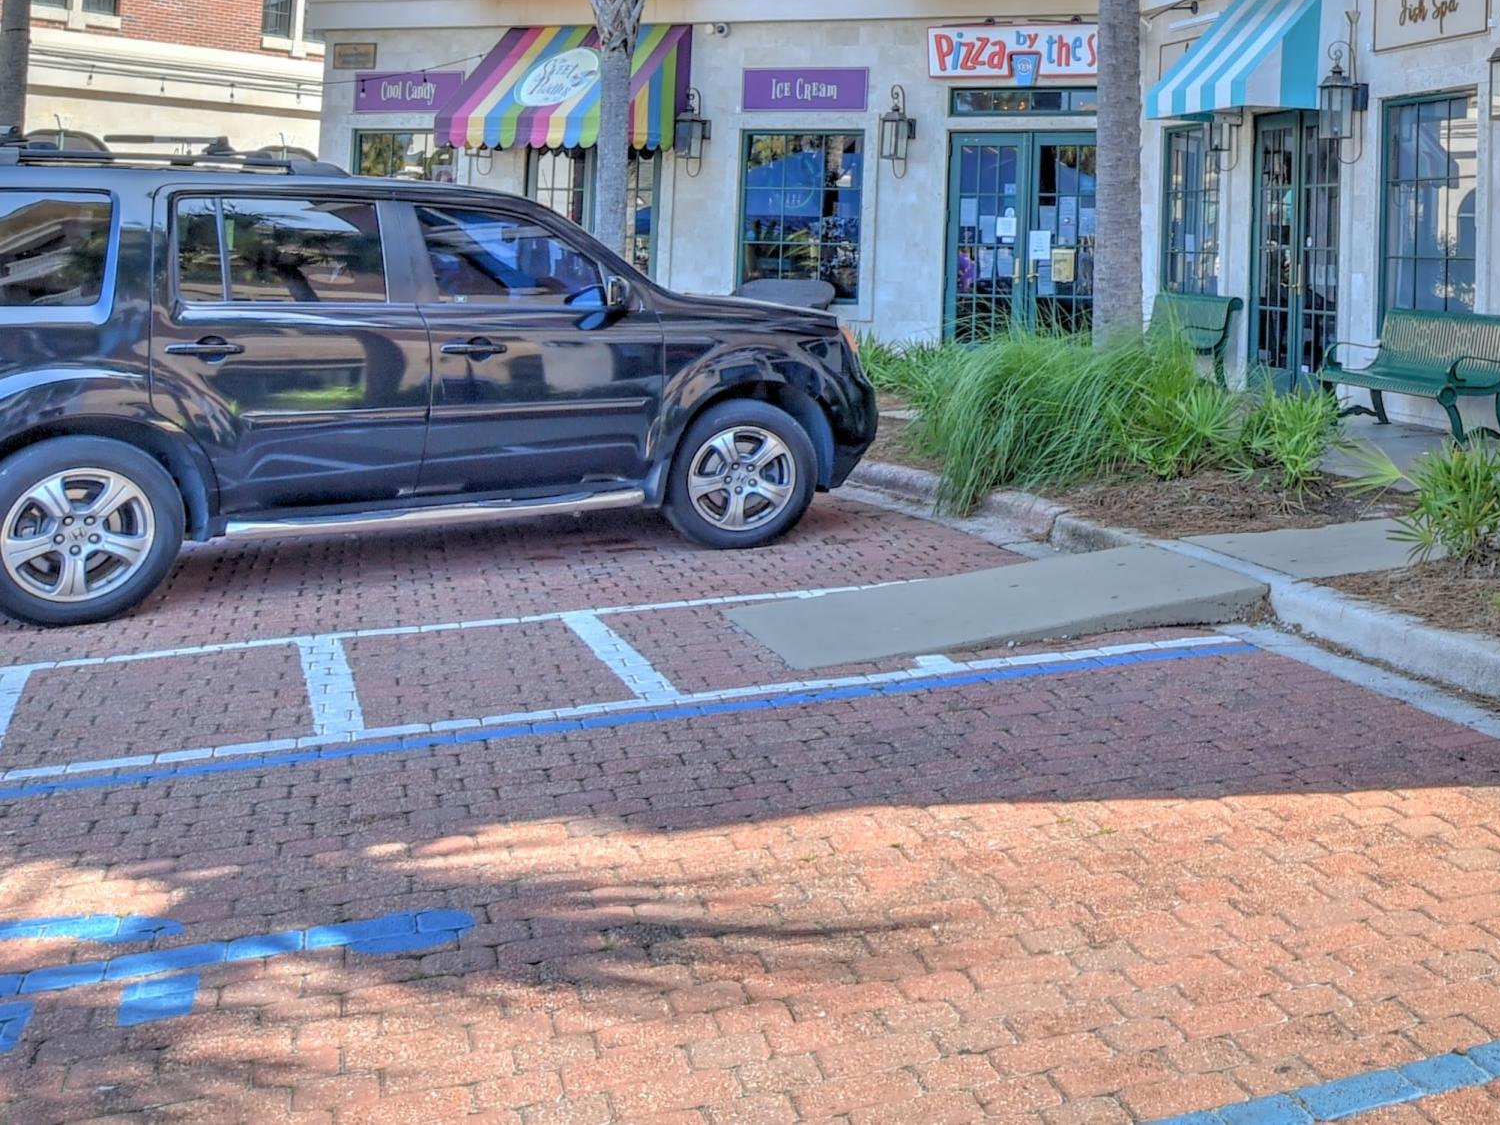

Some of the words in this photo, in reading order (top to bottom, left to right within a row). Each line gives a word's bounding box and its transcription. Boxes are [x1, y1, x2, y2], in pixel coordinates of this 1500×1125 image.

[934, 32, 1007, 72] Pizza
[1015, 30, 1039, 49] by
[1046, 34, 1082, 68] the
[380, 81, 402, 101] Cool
[405, 80, 437, 105] Candy
